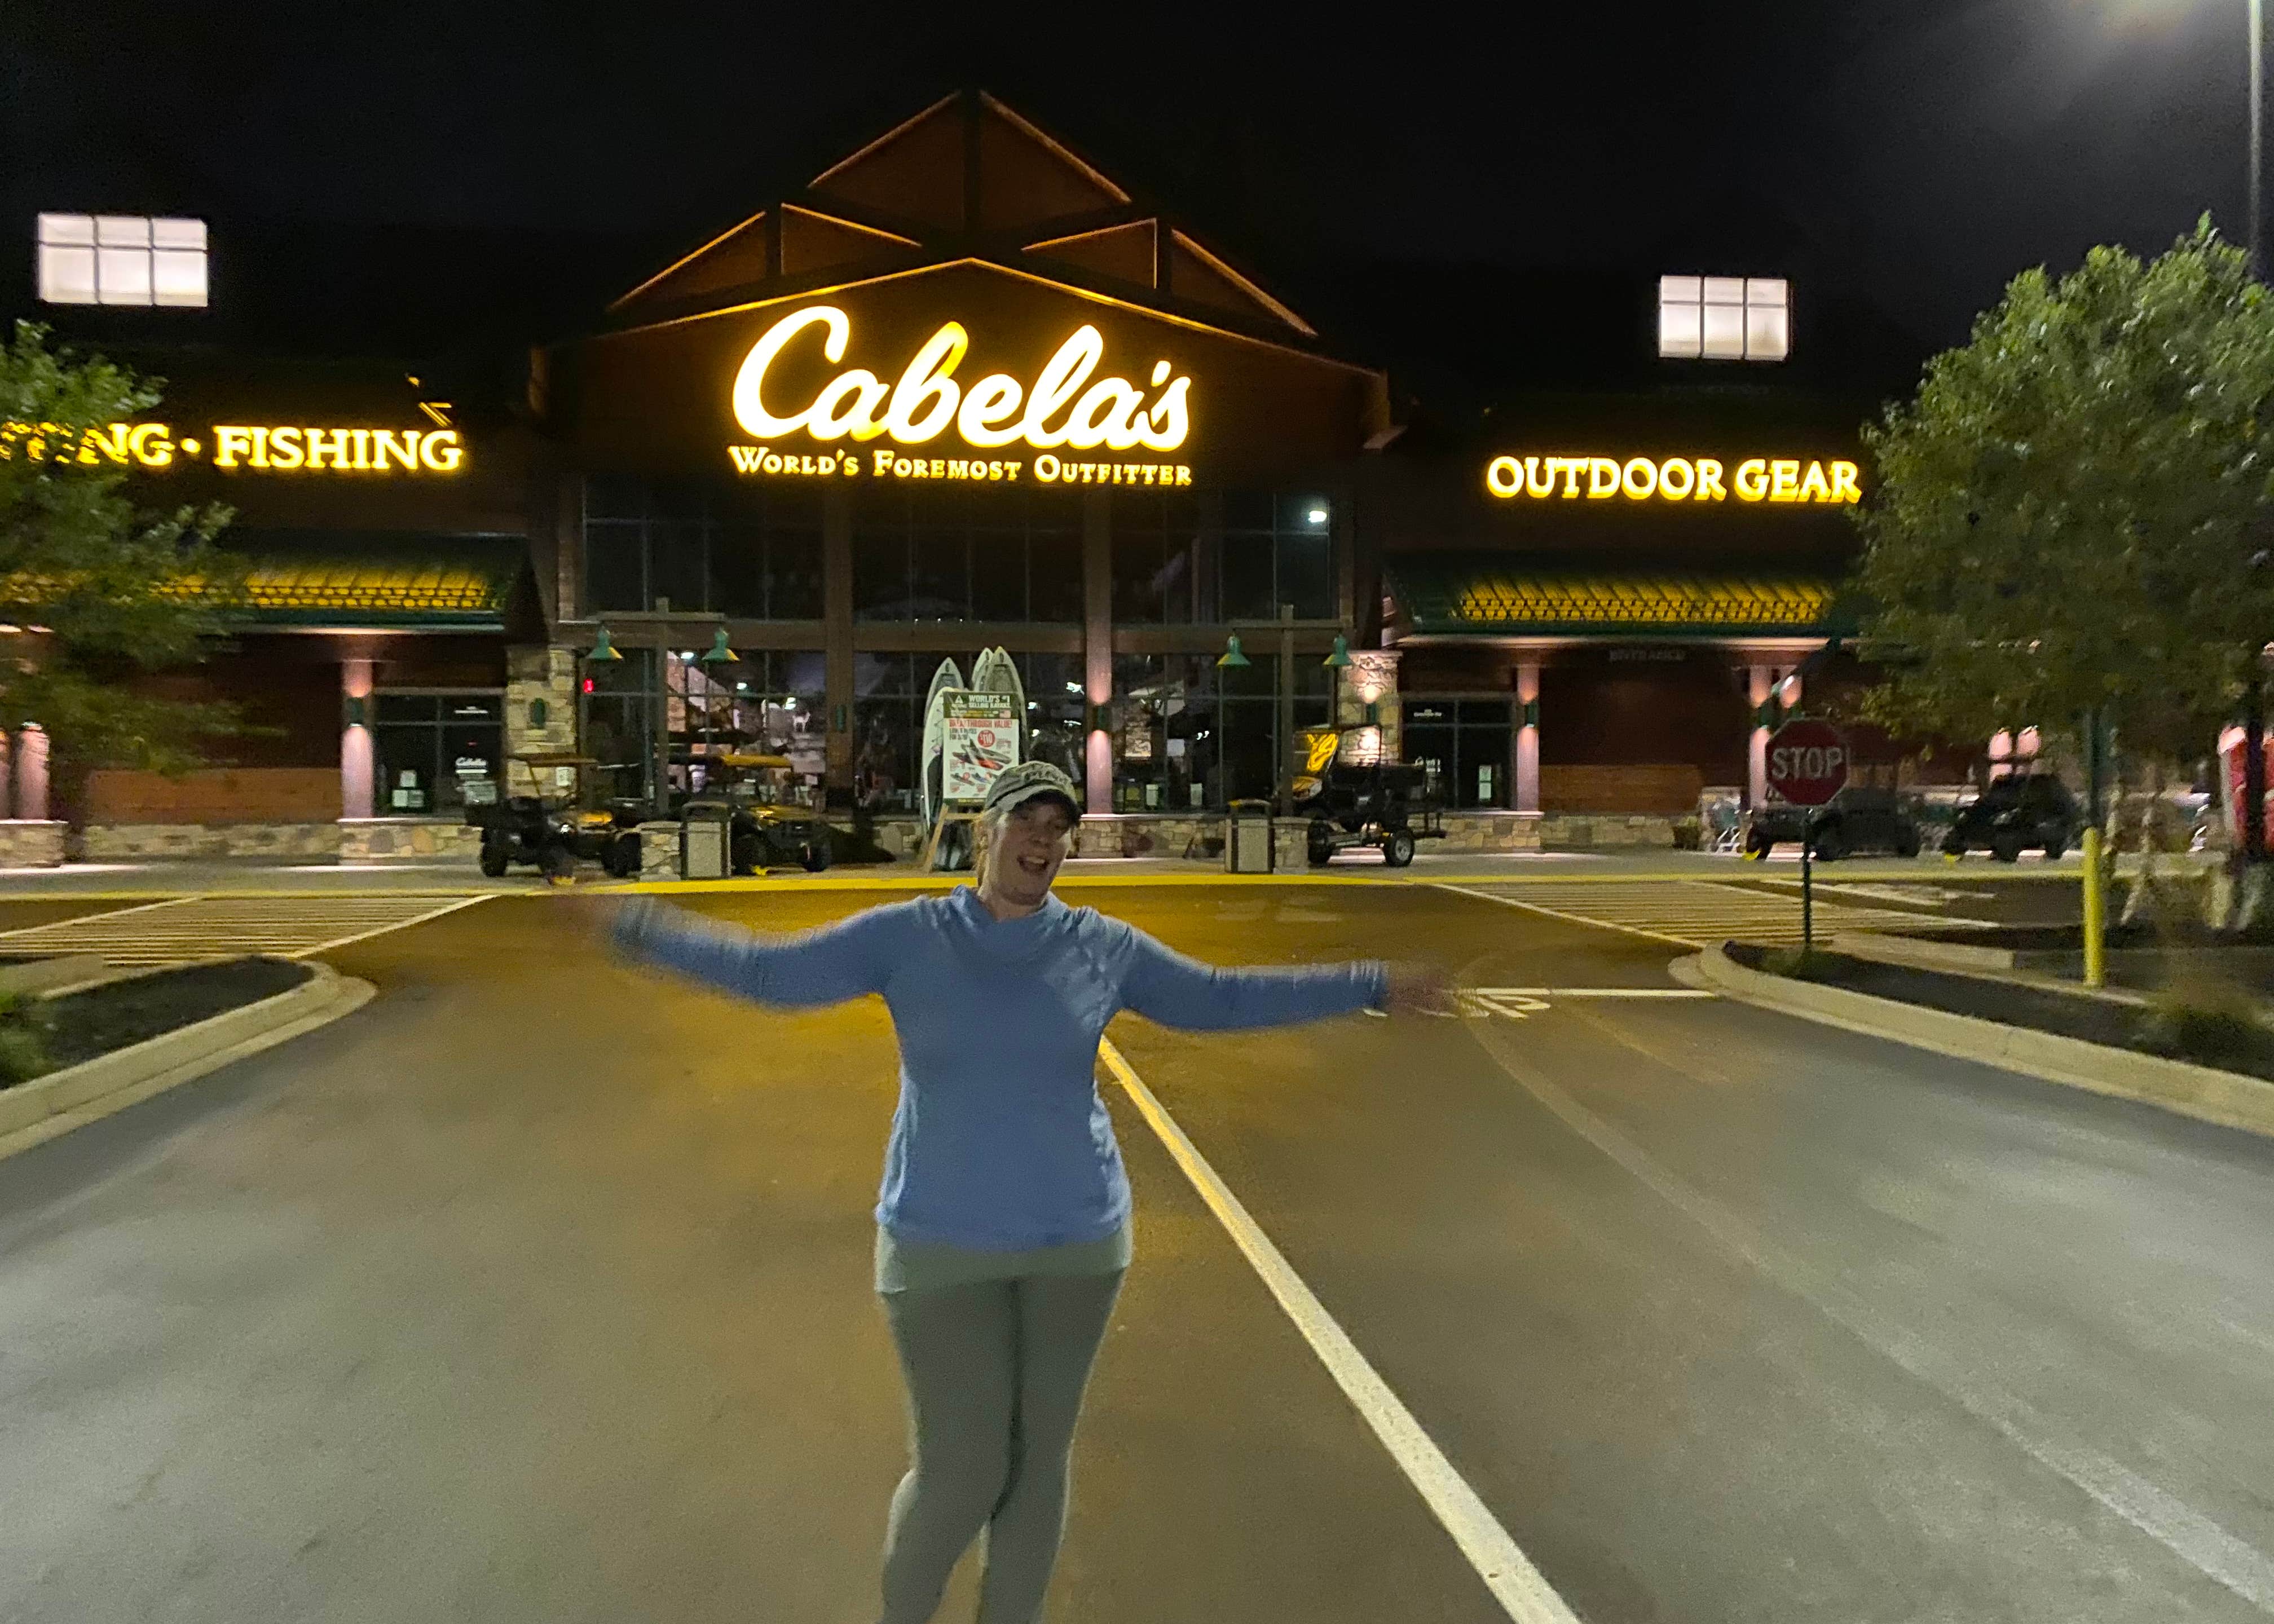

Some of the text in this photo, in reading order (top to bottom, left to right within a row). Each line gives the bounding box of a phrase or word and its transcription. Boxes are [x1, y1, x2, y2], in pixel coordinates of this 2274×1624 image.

[732, 305, 1192, 452] Cabela's
[212, 423, 464, 471] FISHING
[728, 445, 1192, 486] WORLD'S FOREMOST OUTFITTER
[1487, 456, 1862, 504] OUTDOOR GEAR
[968, 694, 1001, 703] WORLD'S
[1772, 747, 1843, 779] STOP
